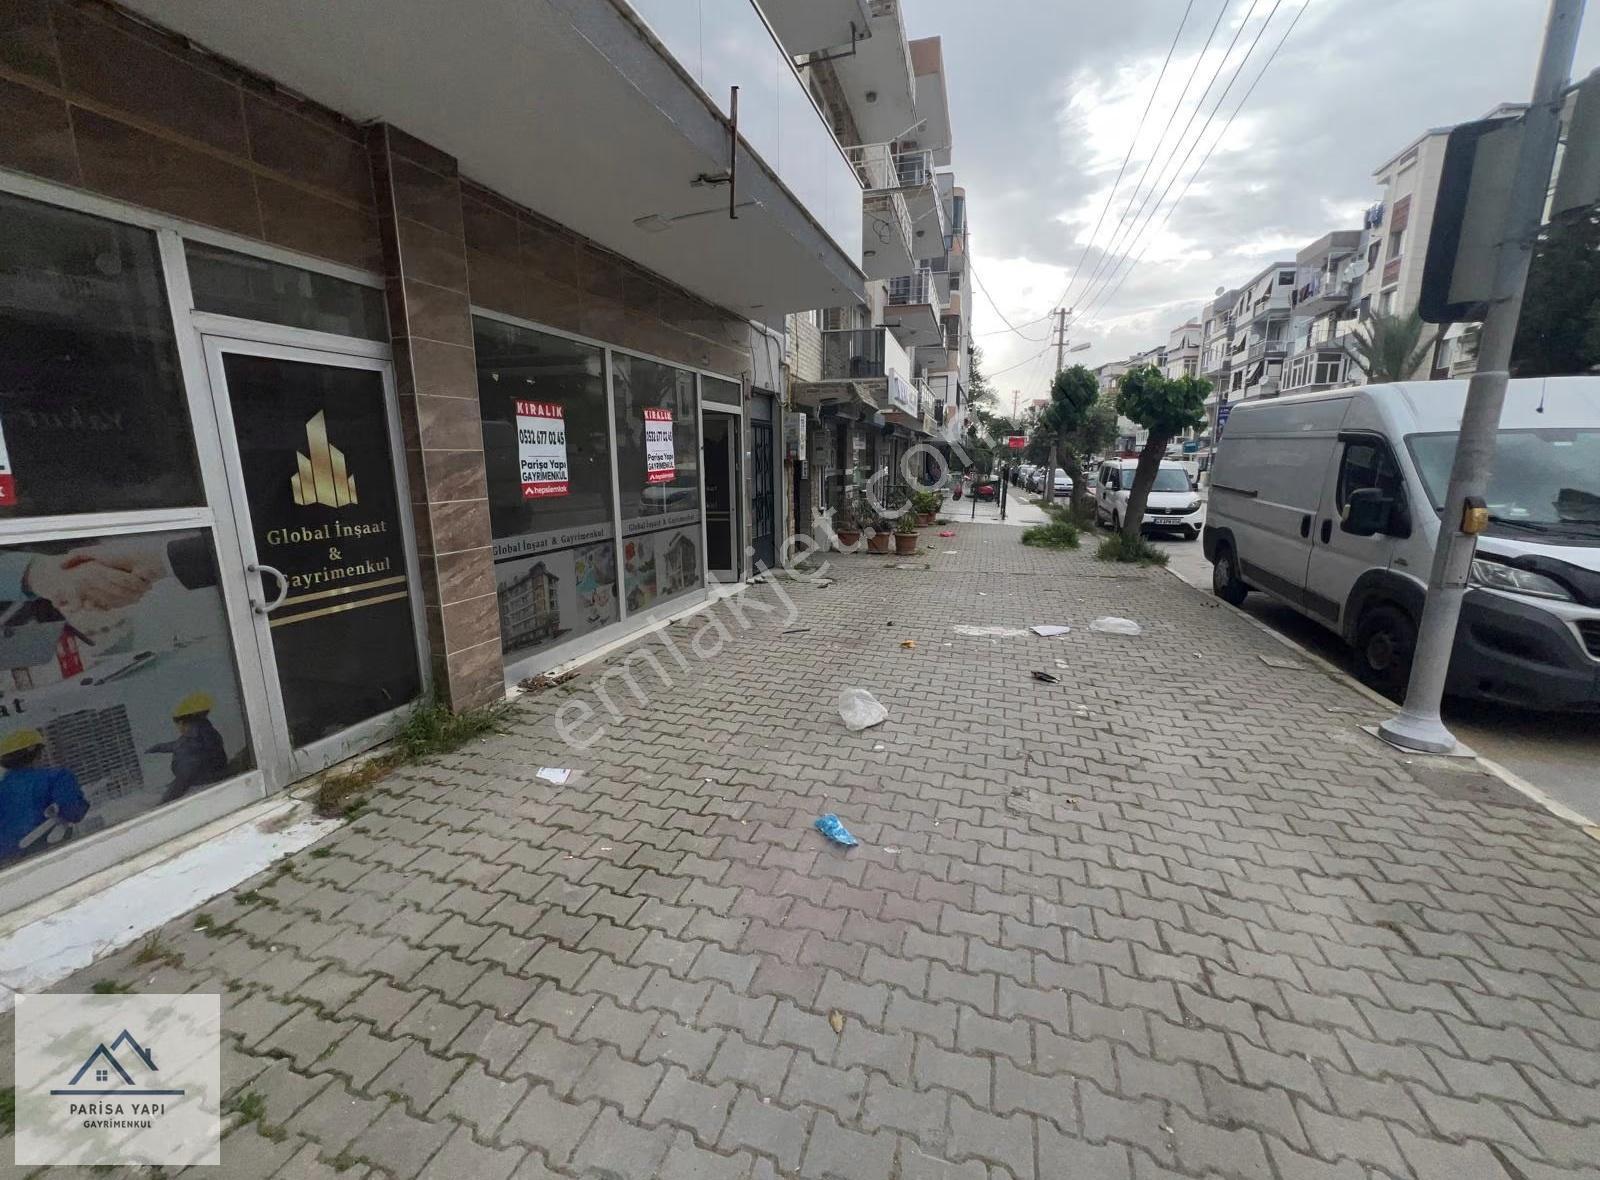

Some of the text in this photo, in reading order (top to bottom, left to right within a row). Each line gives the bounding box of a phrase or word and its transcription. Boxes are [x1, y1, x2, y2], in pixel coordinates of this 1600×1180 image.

[516, 401, 563, 417] KIRALIK
[644, 410, 673, 420] KIRALIK
[519, 429, 536, 445] 0532
[536, 430, 547, 445] 677
[548, 431, 556, 445] 02
[267, 520, 388, 545] Global İnşaat
[329, 546, 342, 561] &
[493, 543, 520, 556] Global
[551, 536, 557, 545] &
